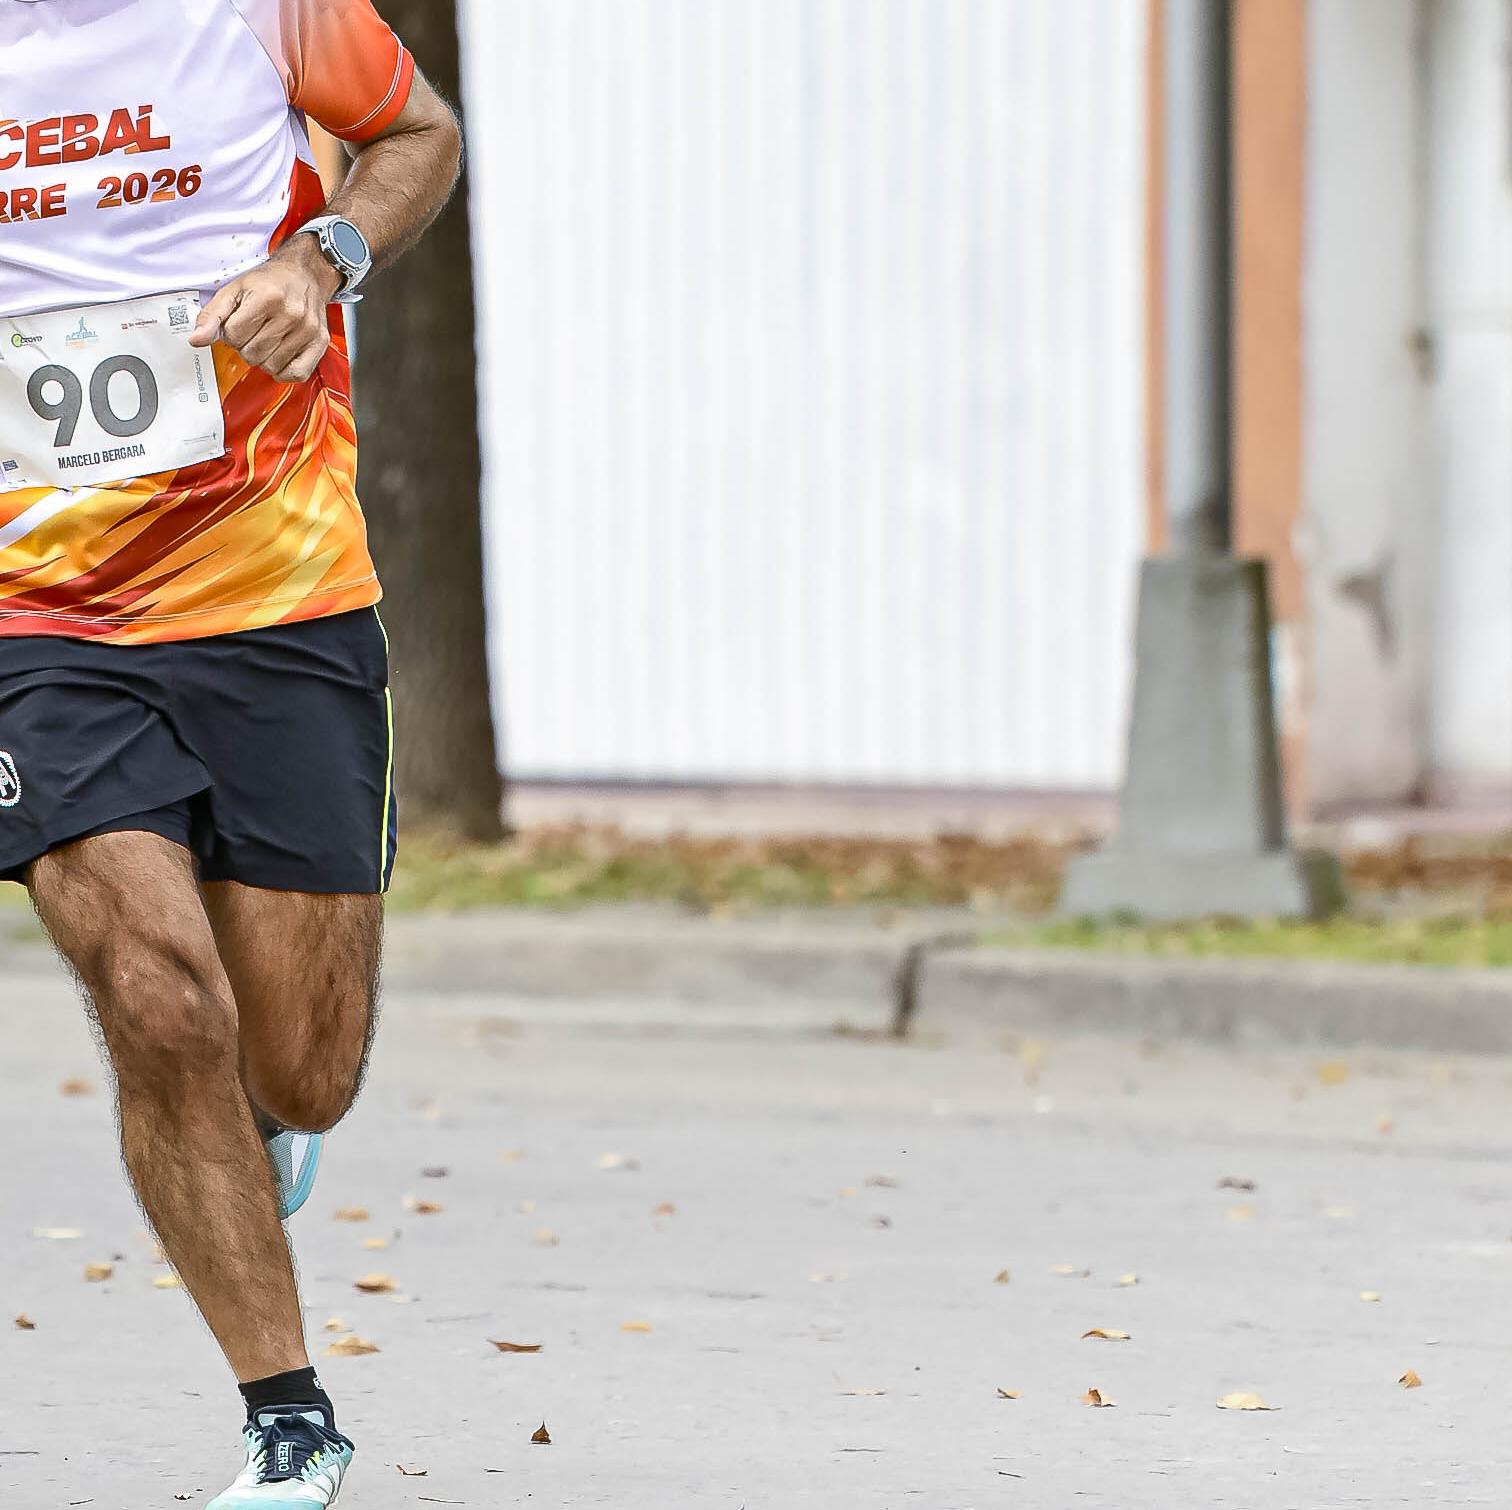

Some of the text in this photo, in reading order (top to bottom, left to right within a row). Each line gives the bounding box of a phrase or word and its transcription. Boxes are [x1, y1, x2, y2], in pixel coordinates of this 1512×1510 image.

[96, 164, 202, 209] 2026
[26, 354, 159, 448] 90
[57, 443, 146, 470] MARCELO BERGARA
